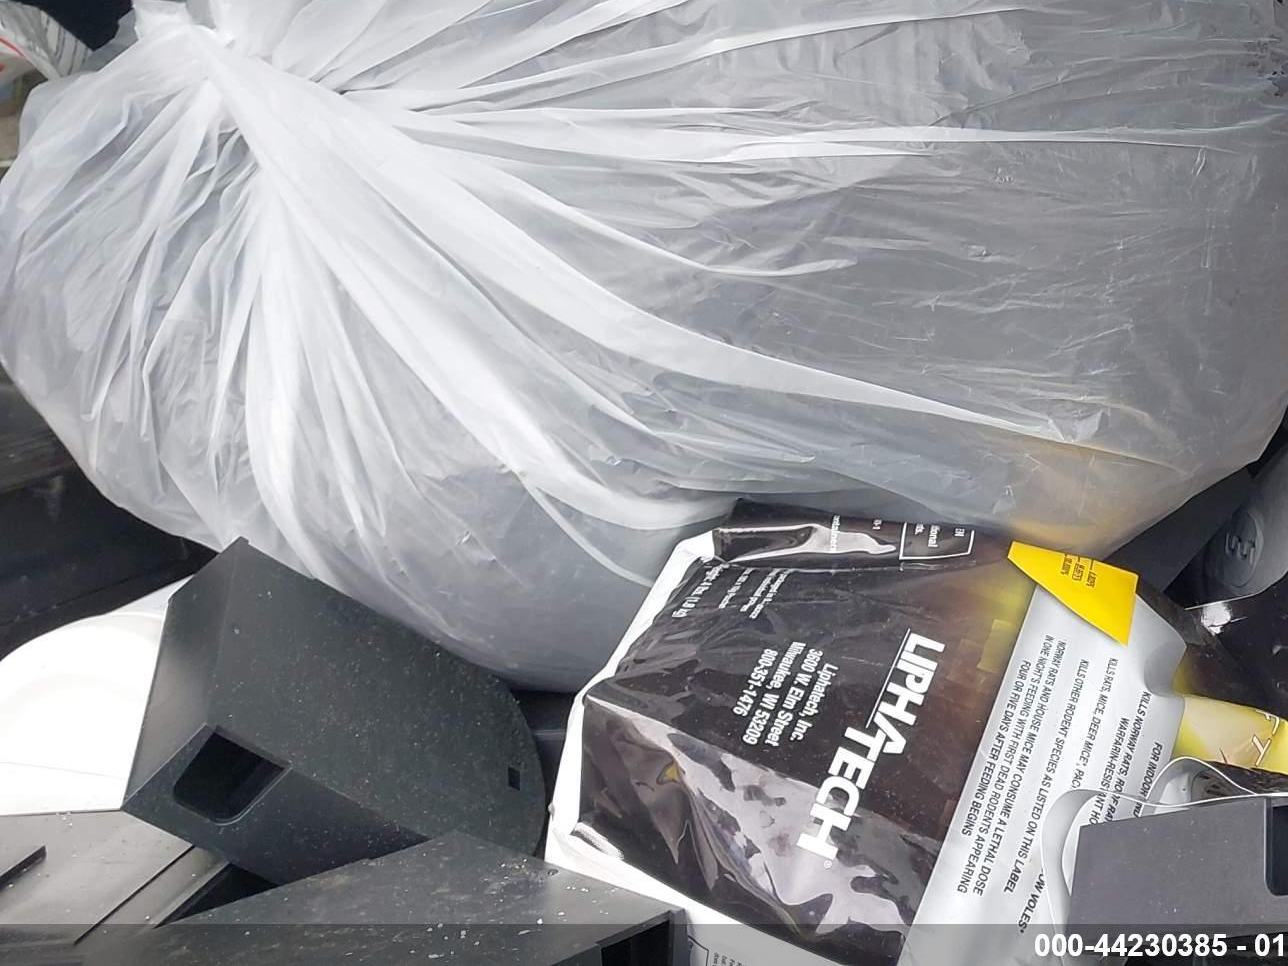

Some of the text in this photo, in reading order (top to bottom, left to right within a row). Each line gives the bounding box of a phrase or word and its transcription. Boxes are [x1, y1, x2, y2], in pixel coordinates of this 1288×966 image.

[1040, 642, 1053, 657] ONE
[1045, 634, 1055, 643] IN
[766, 641, 806, 690] Milwaukee,
[1106, 657, 1119, 676] KILLS
[732, 648, 778, 717] 800-351-1476
[765, 648, 823, 747] 3600 W. Elm Street
[1100, 675, 1114, 693] RATS,
[759, 693, 779, 710] WI
[790, 663, 839, 741] Liphatech, Inc.
[1019, 683, 1038, 718] FEEDING
[1137, 691, 1151, 716] KILLS
[742, 709, 770, 745] 53209
[1011, 718, 1027, 740] WITH
[1087, 715, 1102, 742] DEER
[1127, 715, 1144, 754] NORWAY
[797, 633, 946, 860] LIPHATECH
[961, 660, 1031, 837] FOUR OR FIVE DAYS AFTER FEEDING BEGINS
[1003, 739, 1019, 765] FIRST
[1152, 741, 1163, 762] FOR
[973, 640, 1066, 896] NORWAY RATS AND HOUSE MICE MAY CONSUME A LETHAL DOSE
[994, 765, 1010, 791] DEAD
[1003, 659, 1089, 893] KILLS OTHER RODENT SPECIES AS LISTED ON THIS LABEL
[1071, 768, 1084, 789] PAC
[1118, 753, 1133, 776] RATS,
[979, 790, 1001, 835] RODENTS
[957, 834, 985, 894] APPEARING
